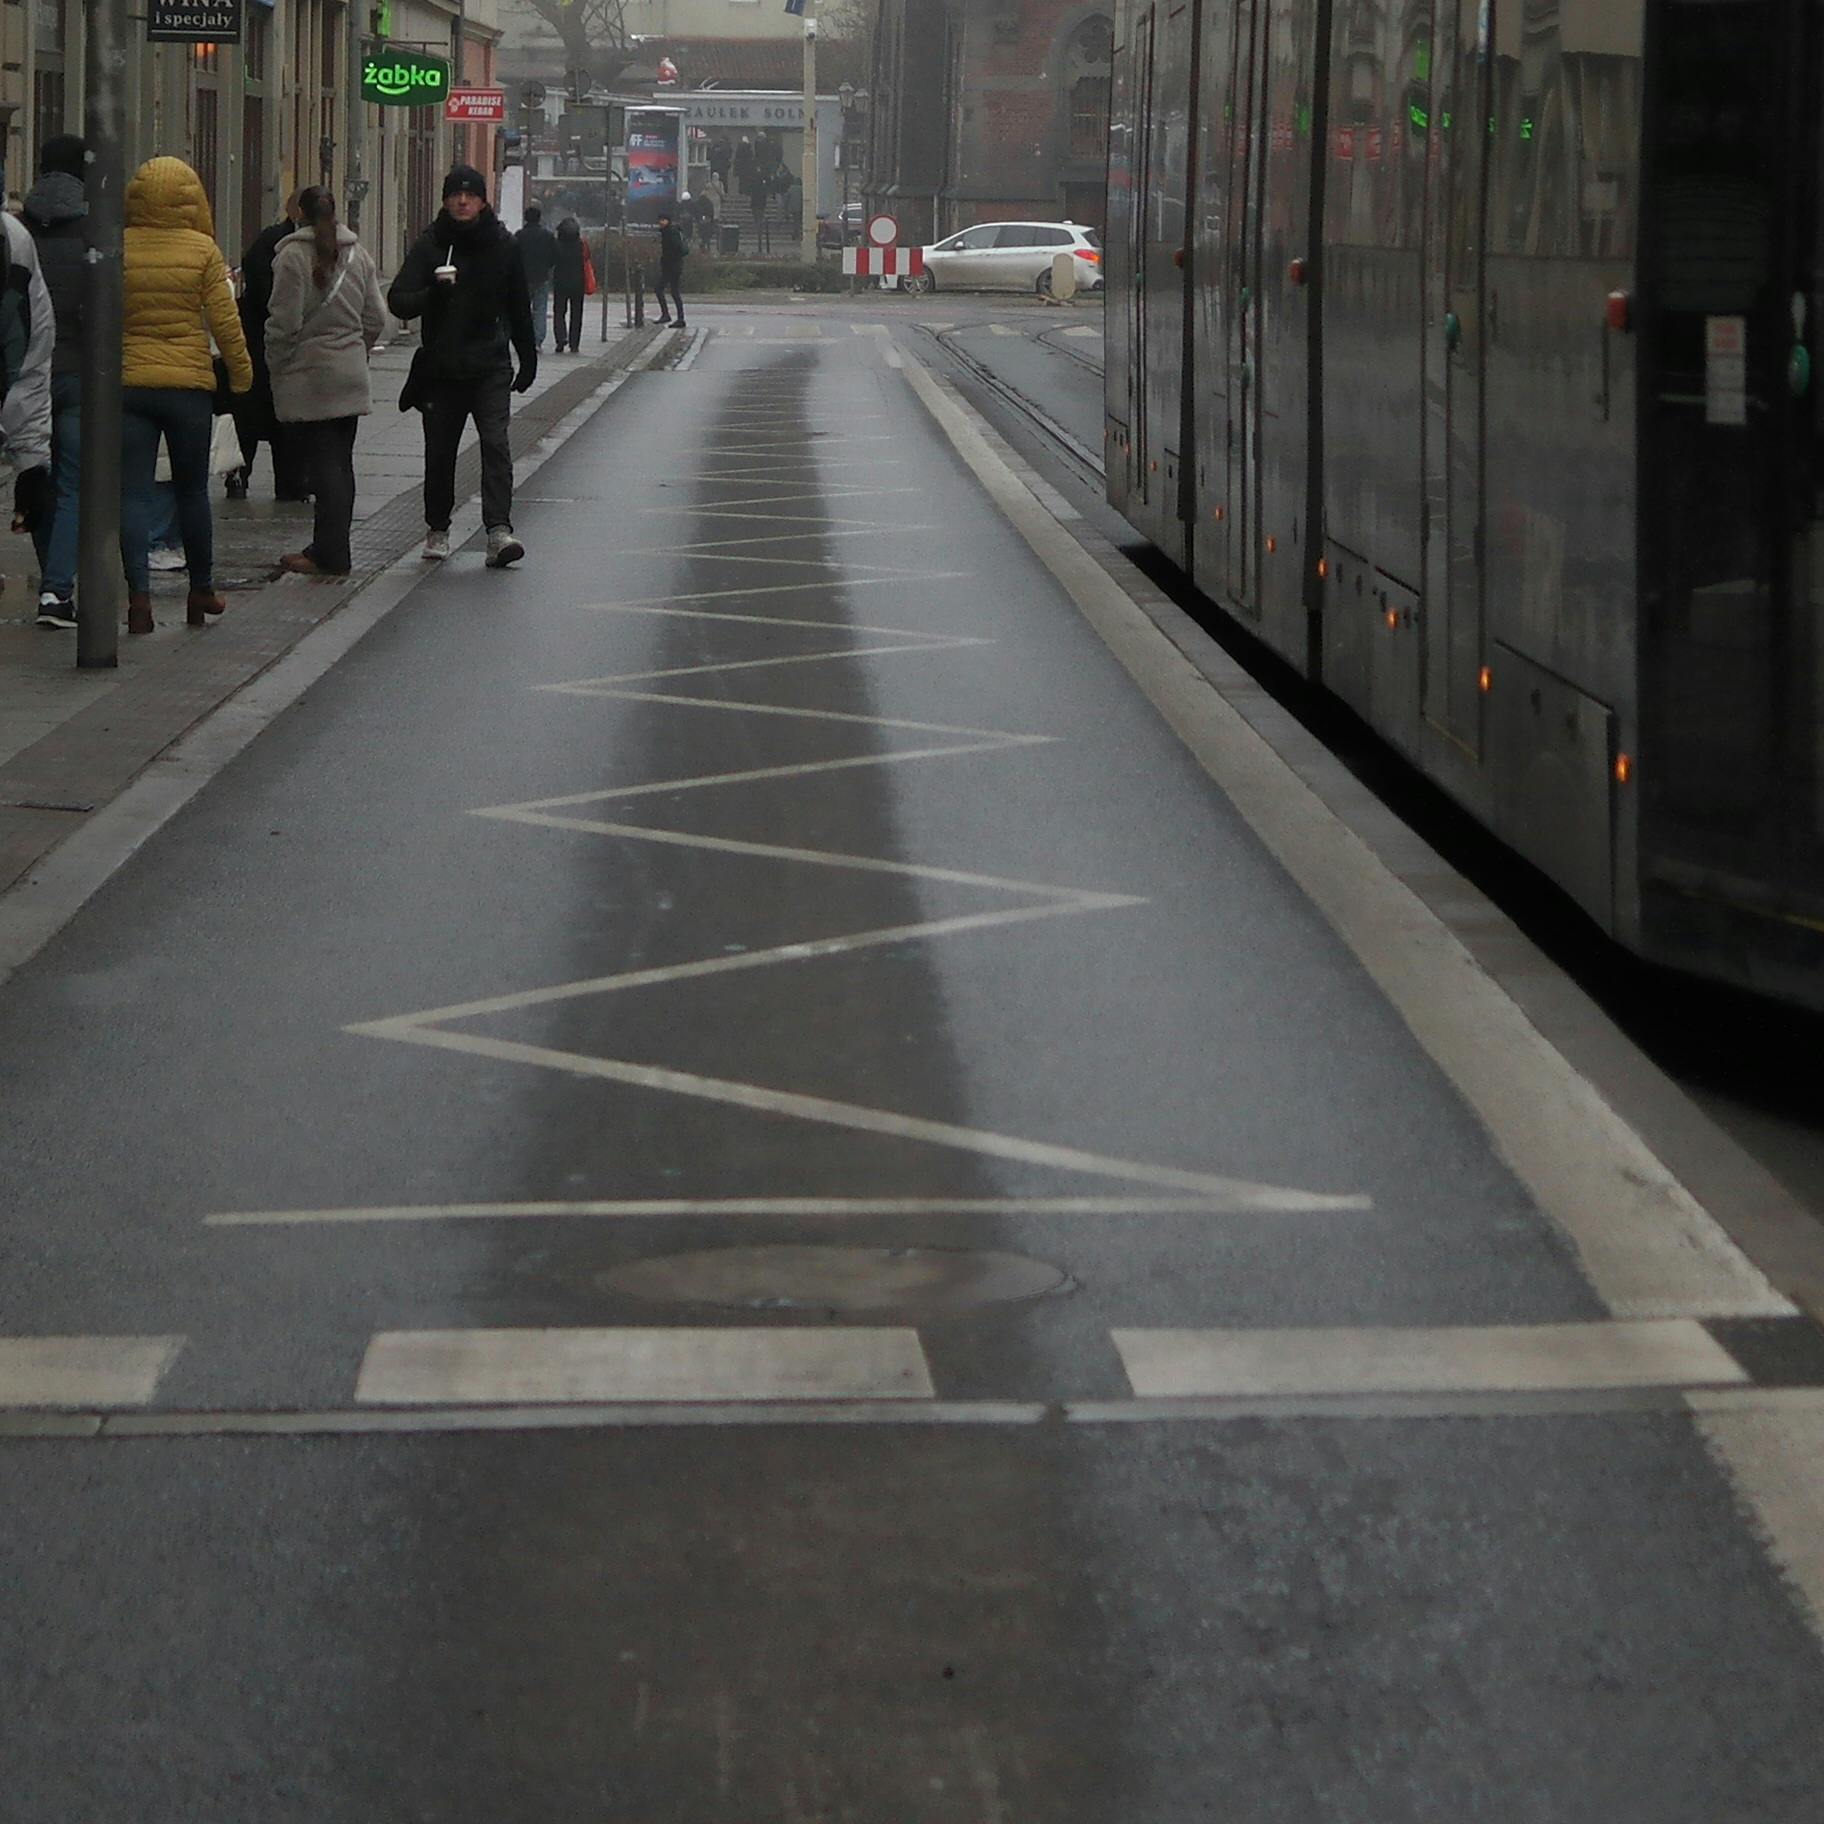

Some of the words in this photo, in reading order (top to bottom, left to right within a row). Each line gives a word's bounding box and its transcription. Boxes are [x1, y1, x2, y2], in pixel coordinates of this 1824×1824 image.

[155, 11, 161, 24] i
[164, 11, 232, 28] specjały
[364, 62, 441, 86] żabka
[460, 95, 502, 106] PARADISE
